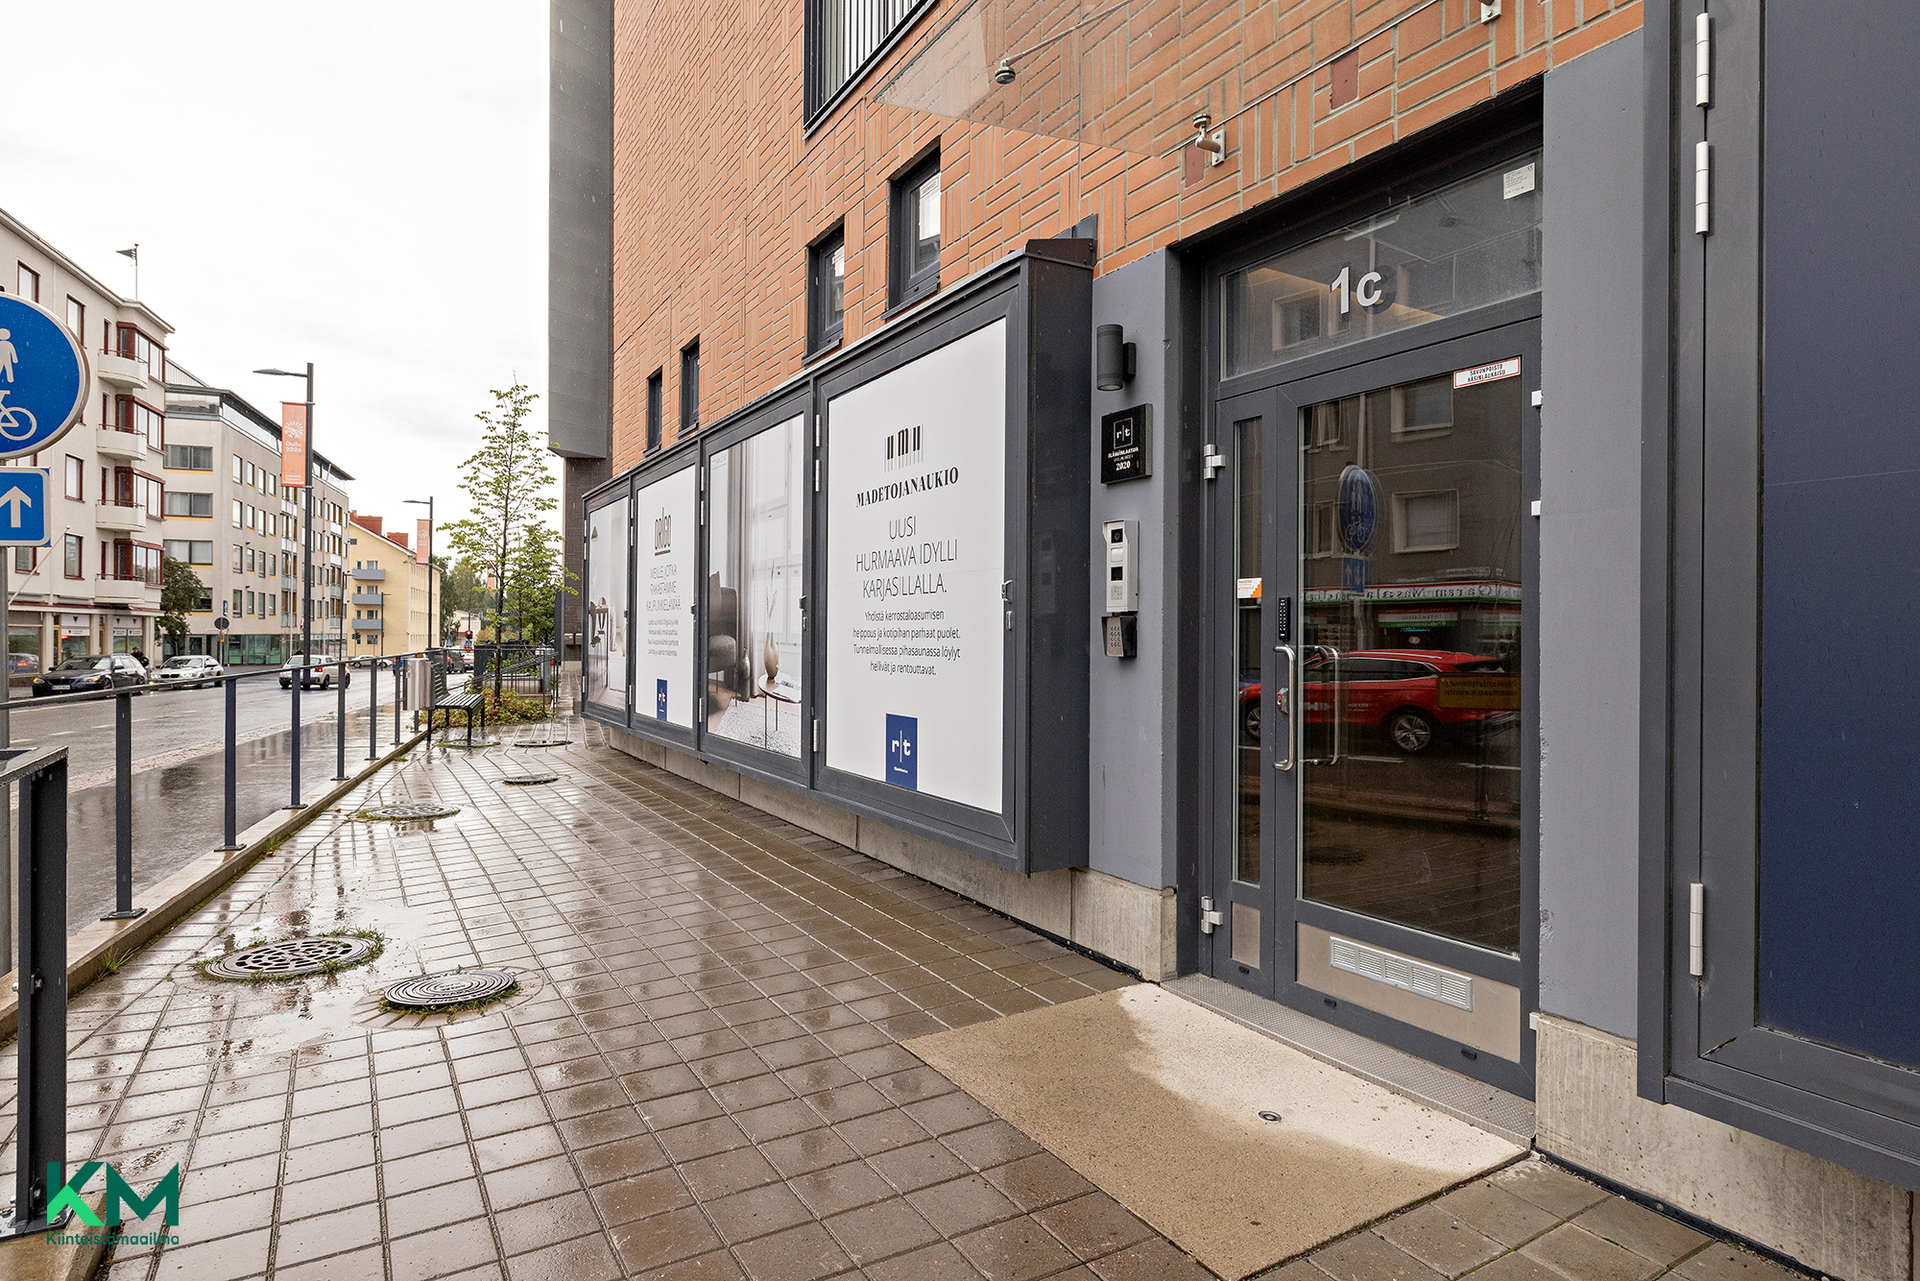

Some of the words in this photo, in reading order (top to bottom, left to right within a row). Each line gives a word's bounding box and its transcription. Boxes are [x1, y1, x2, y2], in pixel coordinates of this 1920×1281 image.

[1470, 363, 1503, 376] SAVUNPOISTO
[1115, 460, 1131, 471] 2020
[856, 466, 959, 508] MADETOJANAUKIO
[889, 515, 917, 540] UUSI
[856, 546, 917, 572] HURMAAVA
[920, 539, 957, 564] IDYLLI
[863, 573, 947, 602] KARJASILLALLA.
[911, 627, 935, 641] parhaat
[937, 627, 961, 641] puolet.
